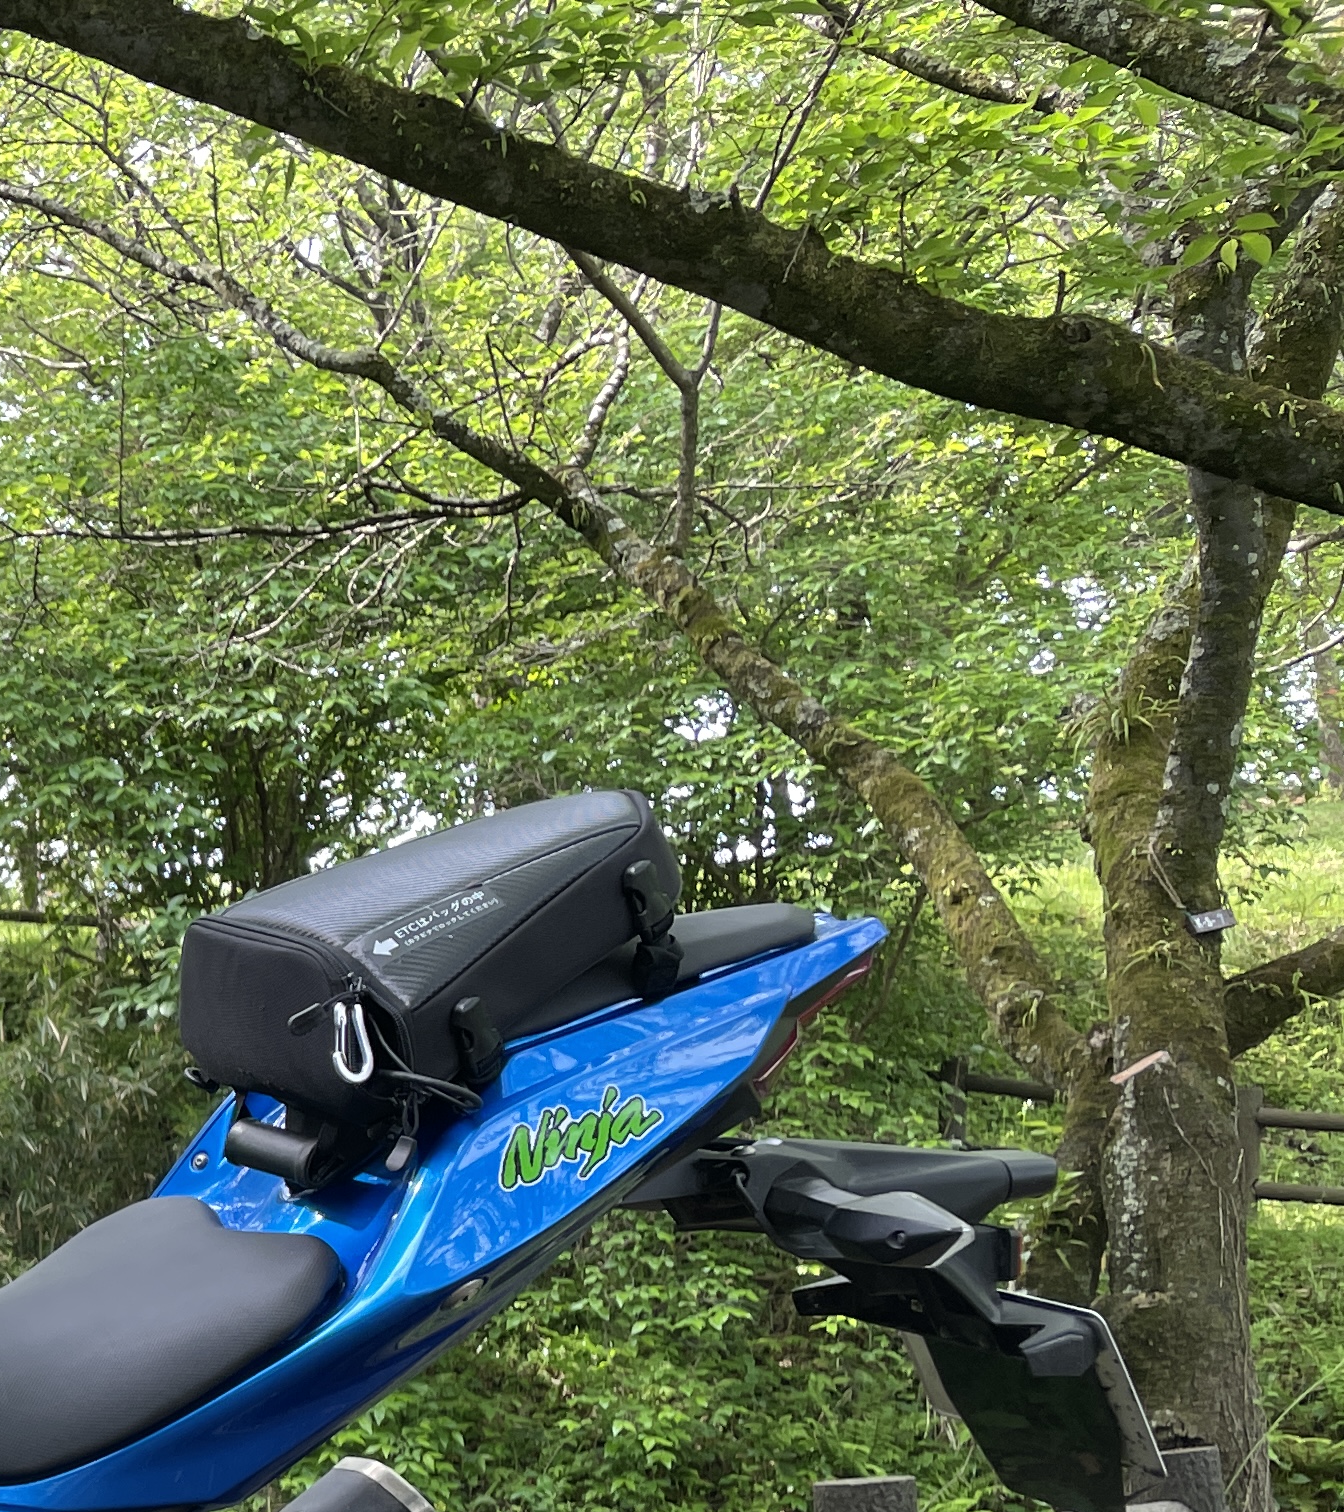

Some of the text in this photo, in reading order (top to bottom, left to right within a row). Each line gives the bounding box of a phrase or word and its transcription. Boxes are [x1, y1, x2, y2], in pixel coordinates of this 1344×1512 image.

[394, 889, 486, 939] ETCはバッグの中
[499, 1084, 664, 1192] Ninja
